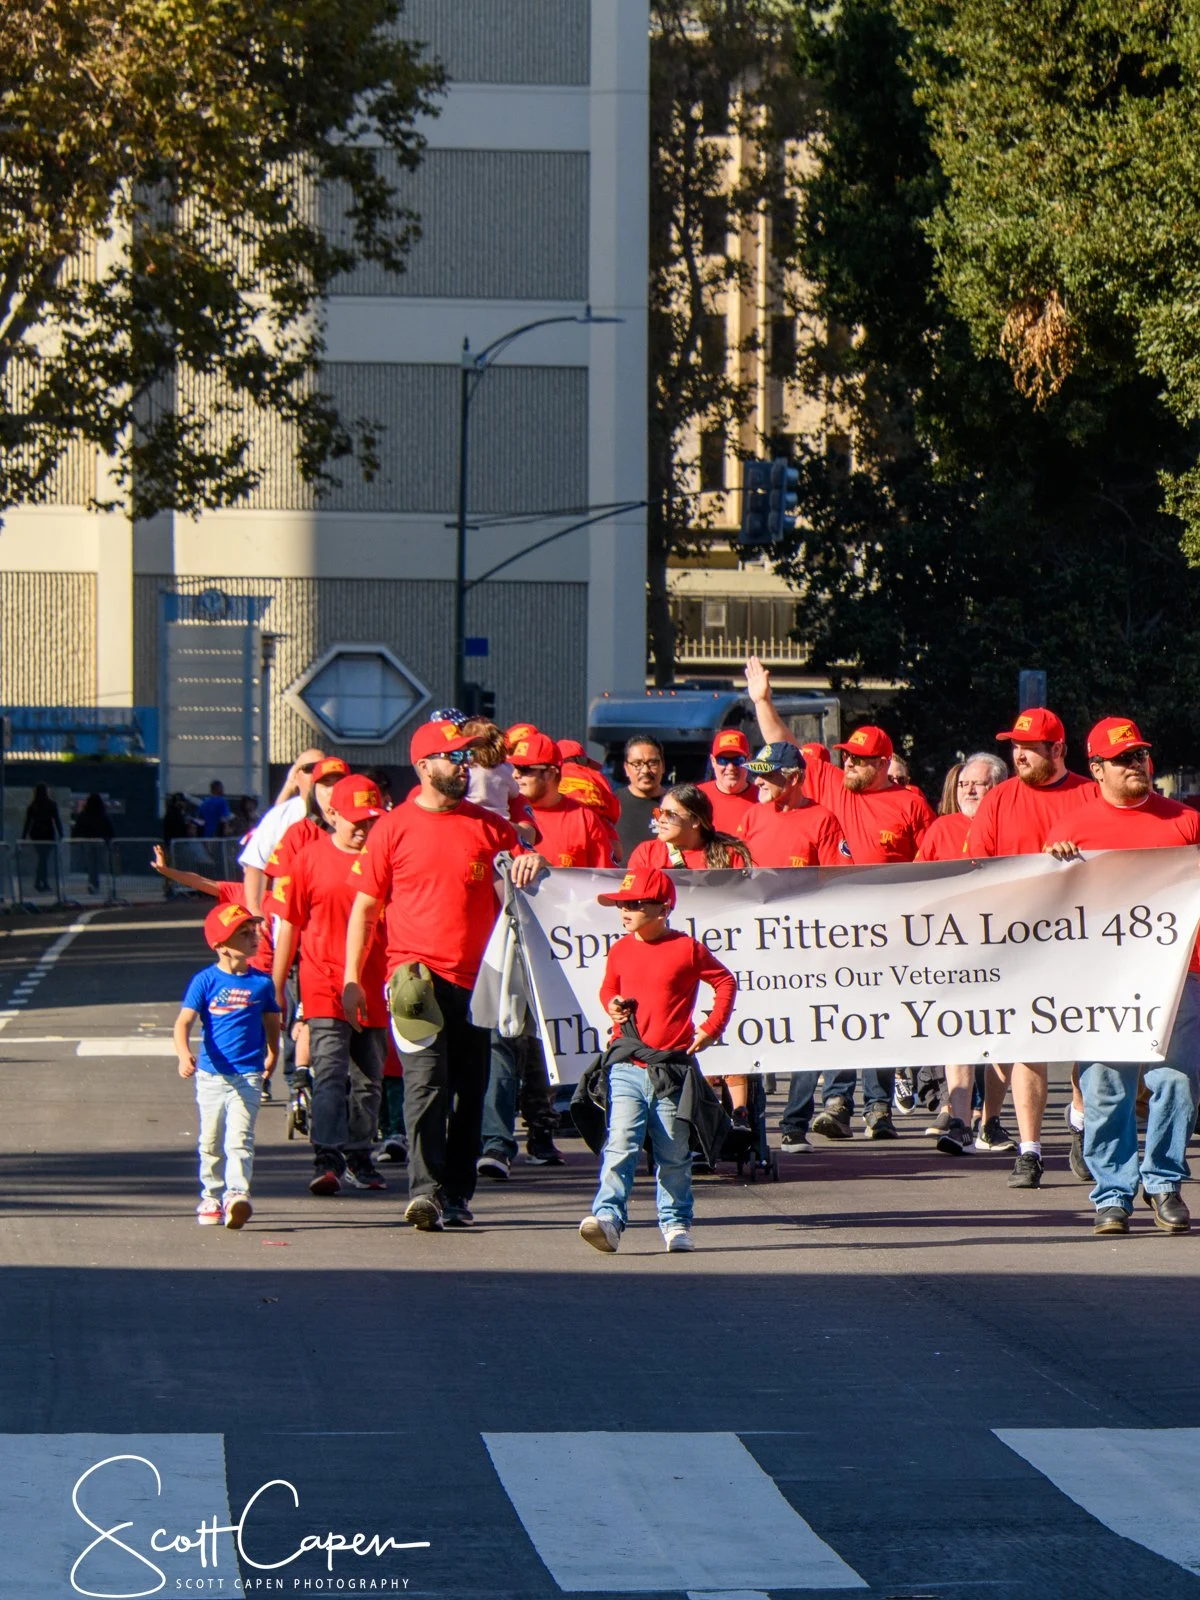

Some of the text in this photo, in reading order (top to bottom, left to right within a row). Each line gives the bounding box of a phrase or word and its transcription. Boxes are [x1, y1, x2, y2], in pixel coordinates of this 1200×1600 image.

[550, 904, 1178, 969] Sprler Fitters UA Local 483
[735, 964, 1001, 992] Honors Our Veterans
[809, 1003, 889, 1043] For
[901, 1000, 1016, 1038] Your
